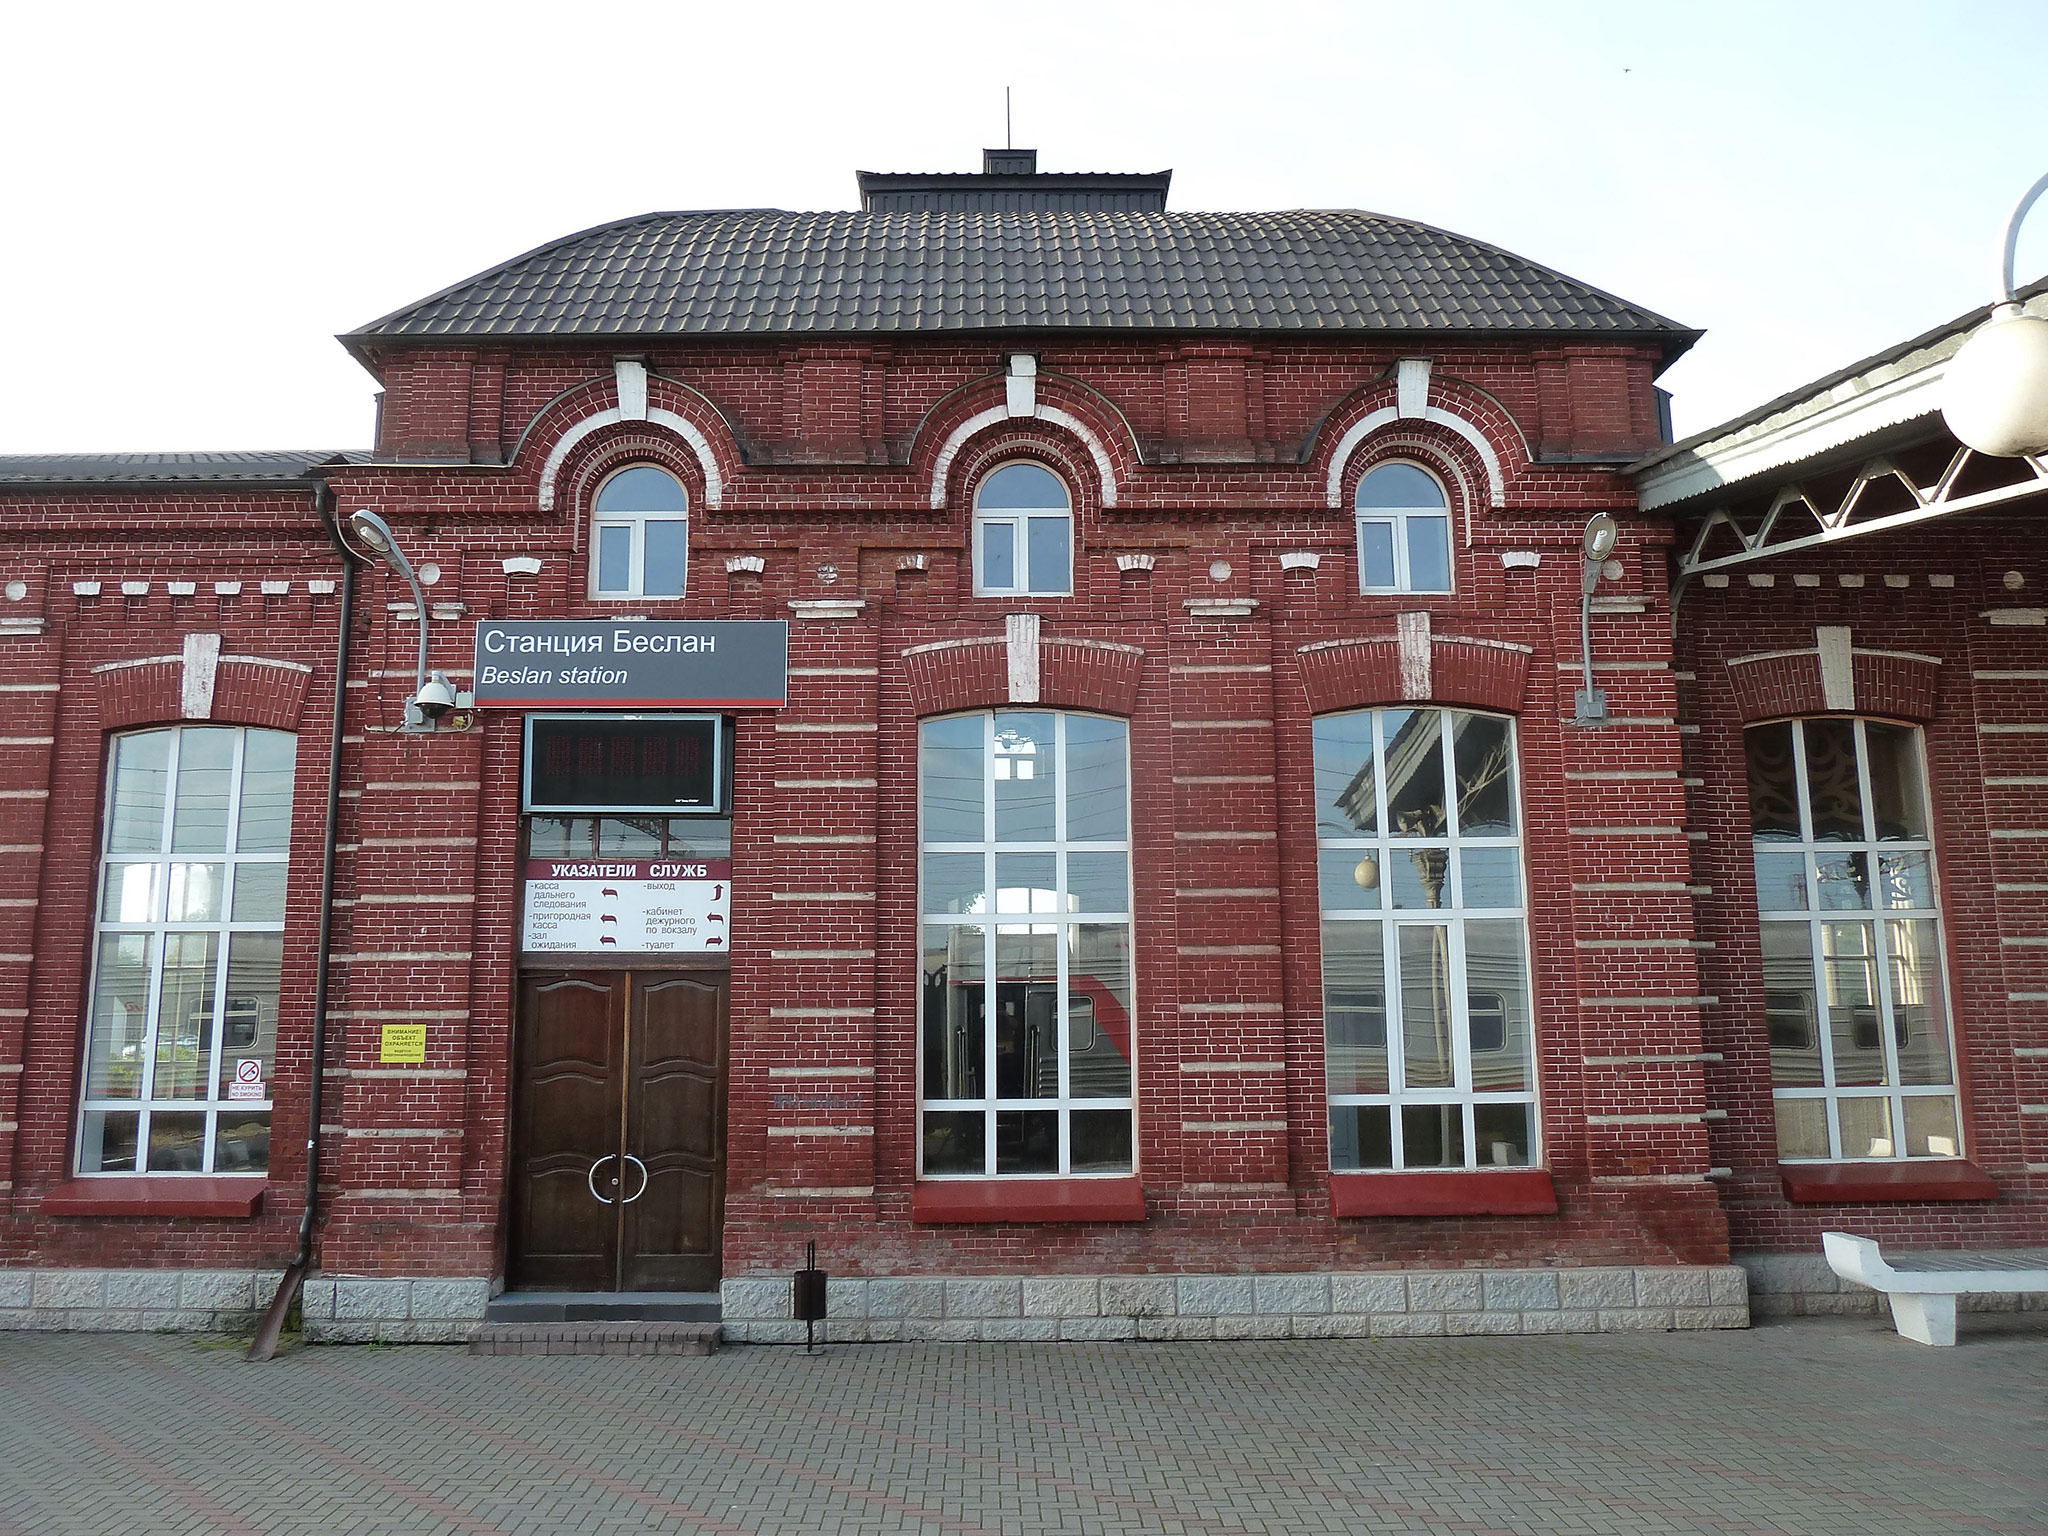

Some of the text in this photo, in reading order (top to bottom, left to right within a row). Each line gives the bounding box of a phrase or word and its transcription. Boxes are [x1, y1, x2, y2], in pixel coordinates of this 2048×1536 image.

[484, 629, 716, 657] Станция Беслан
[481, 666, 628, 684] Beslan station
[551, 864, 708, 877] УКАЗАТЕЛИ СЛУЖБ
[533, 891, 576, 900] дальнего
[533, 901, 587, 909] следования
[645, 917, 696, 926] дежурного
[661, 926, 698, 935] вокзалу
[531, 941, 577, 950] ожидания
